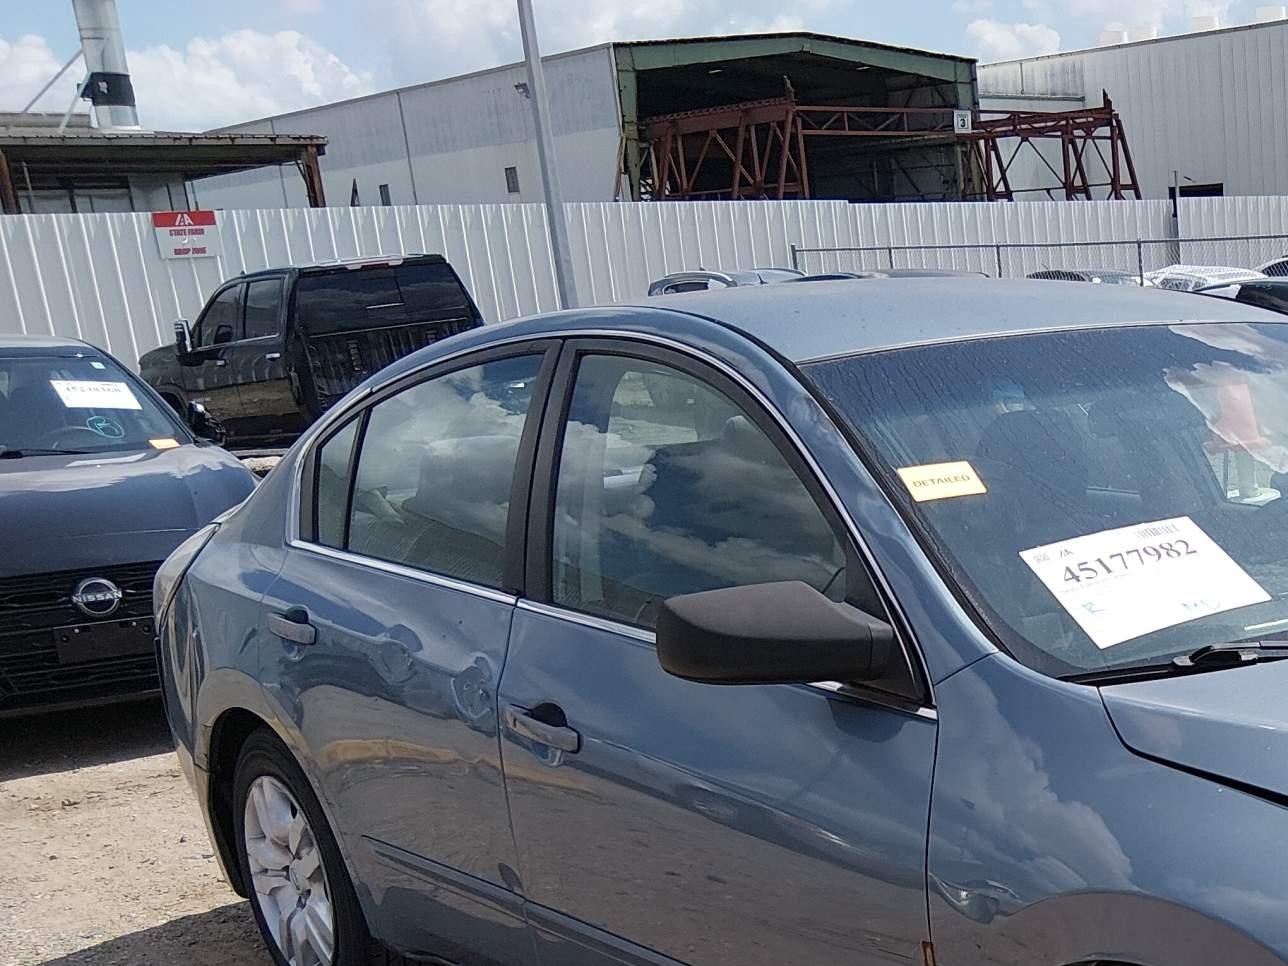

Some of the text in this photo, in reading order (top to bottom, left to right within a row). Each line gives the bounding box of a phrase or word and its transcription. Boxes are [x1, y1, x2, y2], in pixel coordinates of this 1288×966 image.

[960, 118, 966, 128] 3
[912, 474, 971, 487] DETAILED
[1063, 539, 1198, 583] 45177982
[72, 589, 122, 603] NISSAN
